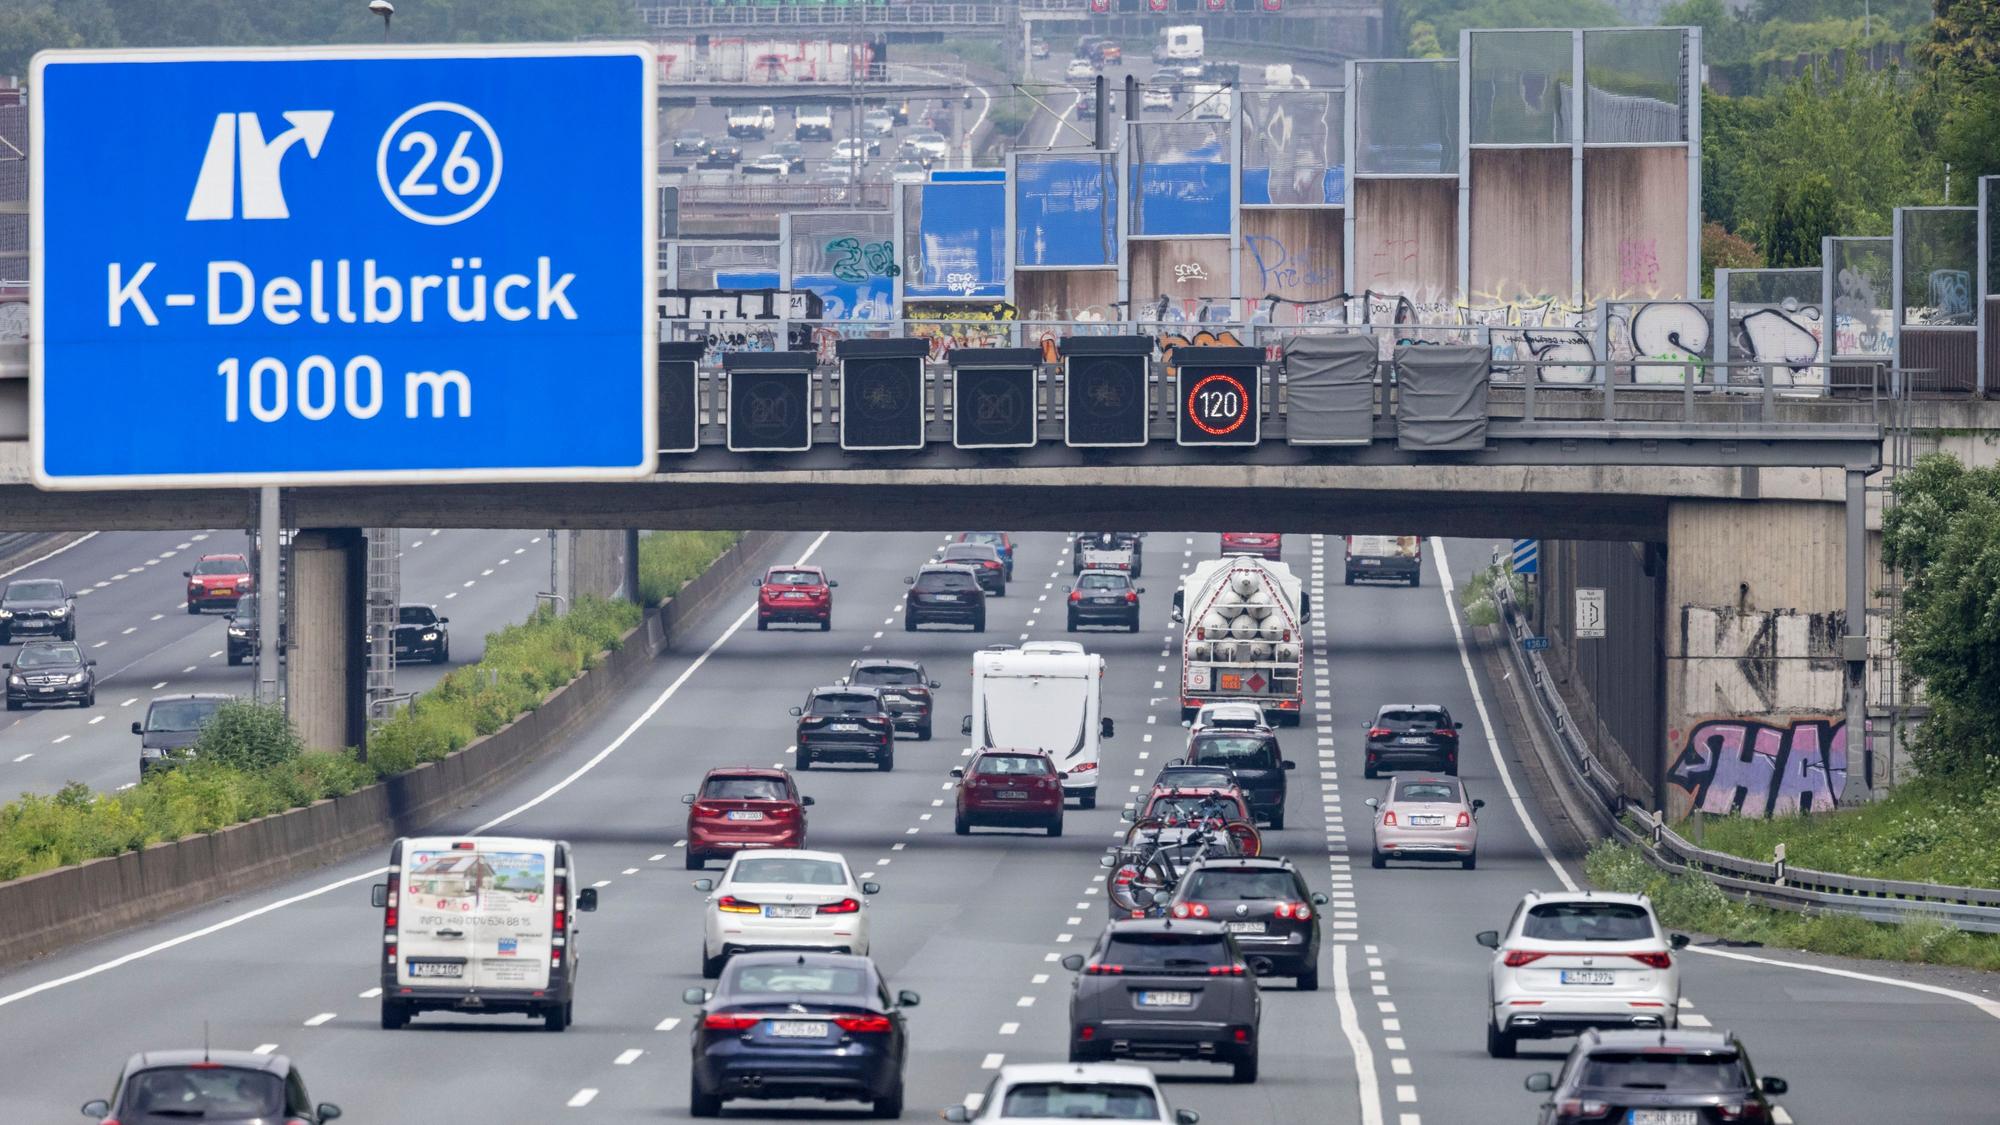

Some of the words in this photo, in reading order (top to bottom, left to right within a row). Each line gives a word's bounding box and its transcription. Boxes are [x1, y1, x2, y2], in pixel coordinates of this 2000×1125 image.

[399, 131, 482, 196] 26
[107, 256, 578, 327] K-Dellbrück
[217, 355, 383, 422] 1000
[405, 369, 472, 419] m
[1200, 391, 1238, 418] 120
